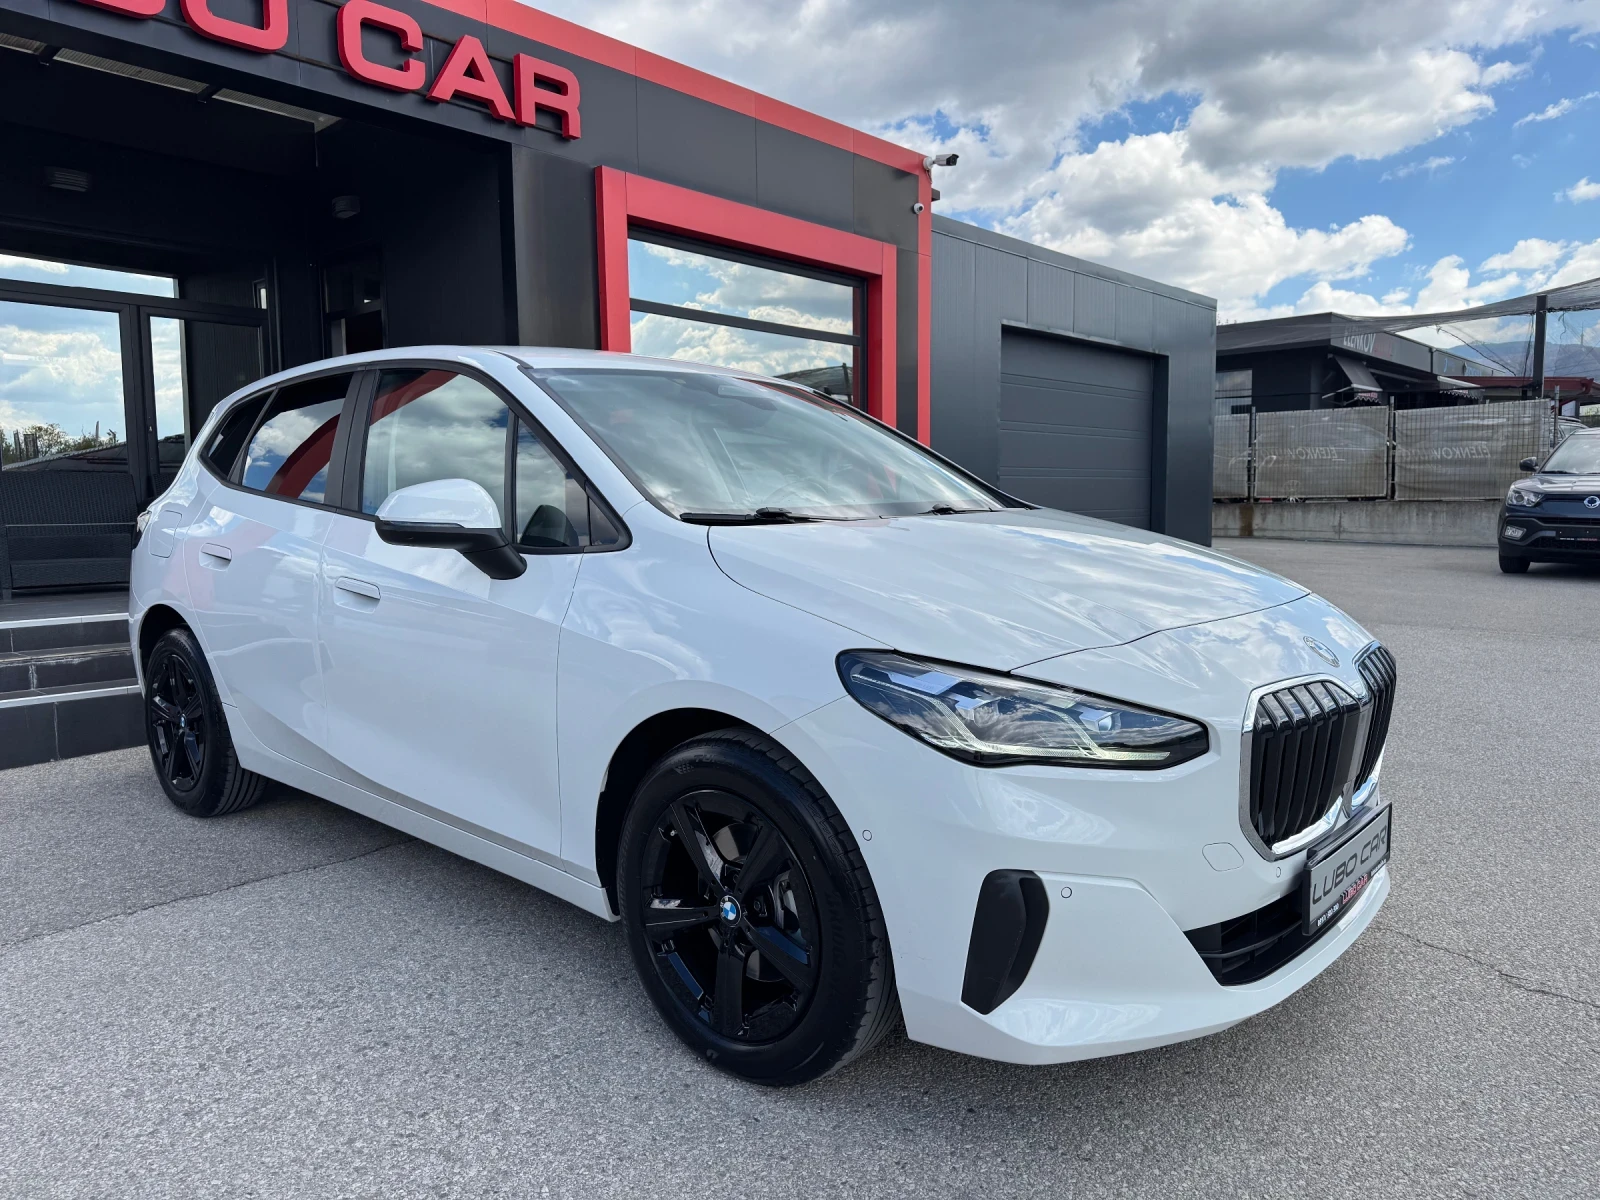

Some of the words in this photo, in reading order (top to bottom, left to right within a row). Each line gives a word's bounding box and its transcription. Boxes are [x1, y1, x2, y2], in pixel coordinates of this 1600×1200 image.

[337, 0, 581, 140] CAR
[1313, 853, 1357, 904] LUBO
[1361, 826, 1387, 865] CAR
